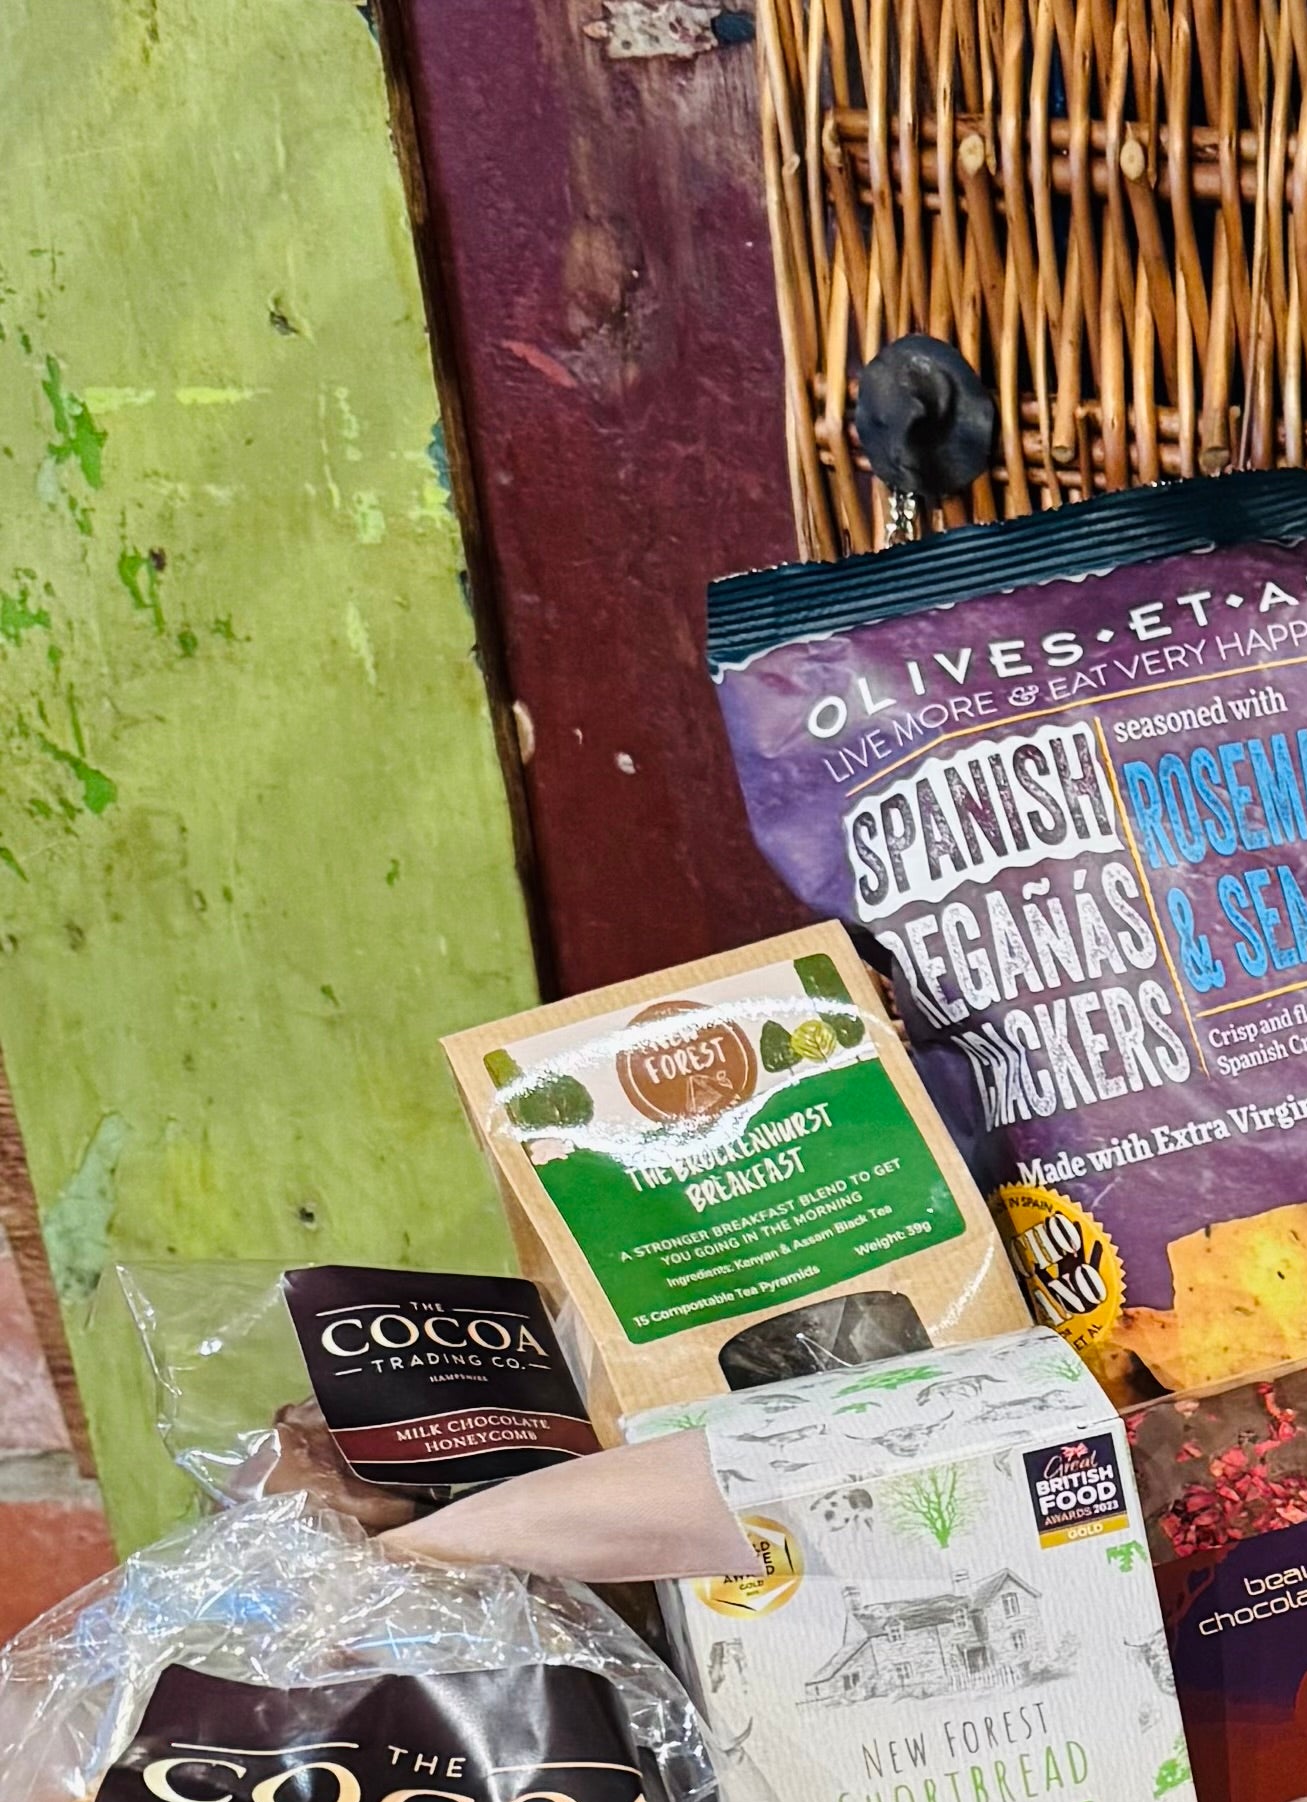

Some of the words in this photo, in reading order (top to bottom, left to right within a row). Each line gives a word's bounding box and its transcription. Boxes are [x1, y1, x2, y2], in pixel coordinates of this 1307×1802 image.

[824, 728, 888, 785] LIVE
[892, 691, 998, 747] MORE
[1008, 683, 1039, 707] &
[1049, 663, 1109, 700] EAT
[1113, 641, 1208, 681] VERY
[1113, 702, 1227, 743] seasoned
[1229, 686, 1288, 725] with
[851, 731, 1114, 908] SPANISH
[1168, 889, 1226, 992] &
[643, 1035, 727, 1085] FOREST
[684, 1147, 806, 1213] BREAKFAST
[1017, 1156, 1088, 1189] Made
[1093, 1128, 1153, 1172] with
[1153, 1118, 1231, 1154] Extra
[620, 1249, 633, 1264] A
[633, 1229, 710, 1259] STRONGER
[711, 1199, 796, 1237] BREAKFAST
[798, 1182, 848, 1208] BLEND
[849, 1172, 872, 1188] TO
[873, 1158, 902, 1180] GET
[320, 1314, 549, 1358] COCOA
[396, 1425, 443, 1443] MILK
[447, 1414, 551, 1433] CHOCOLATE
[425, 1430, 538, 1455] HONEYCOMB
[1036, 1467, 1115, 1498] BRITISH
[1039, 1481, 1117, 1516] FOOD
[388, 1745, 468, 1779] THE
[861, 1730, 937, 1781] NEW
[944, 1701, 1051, 1757] FOREST
